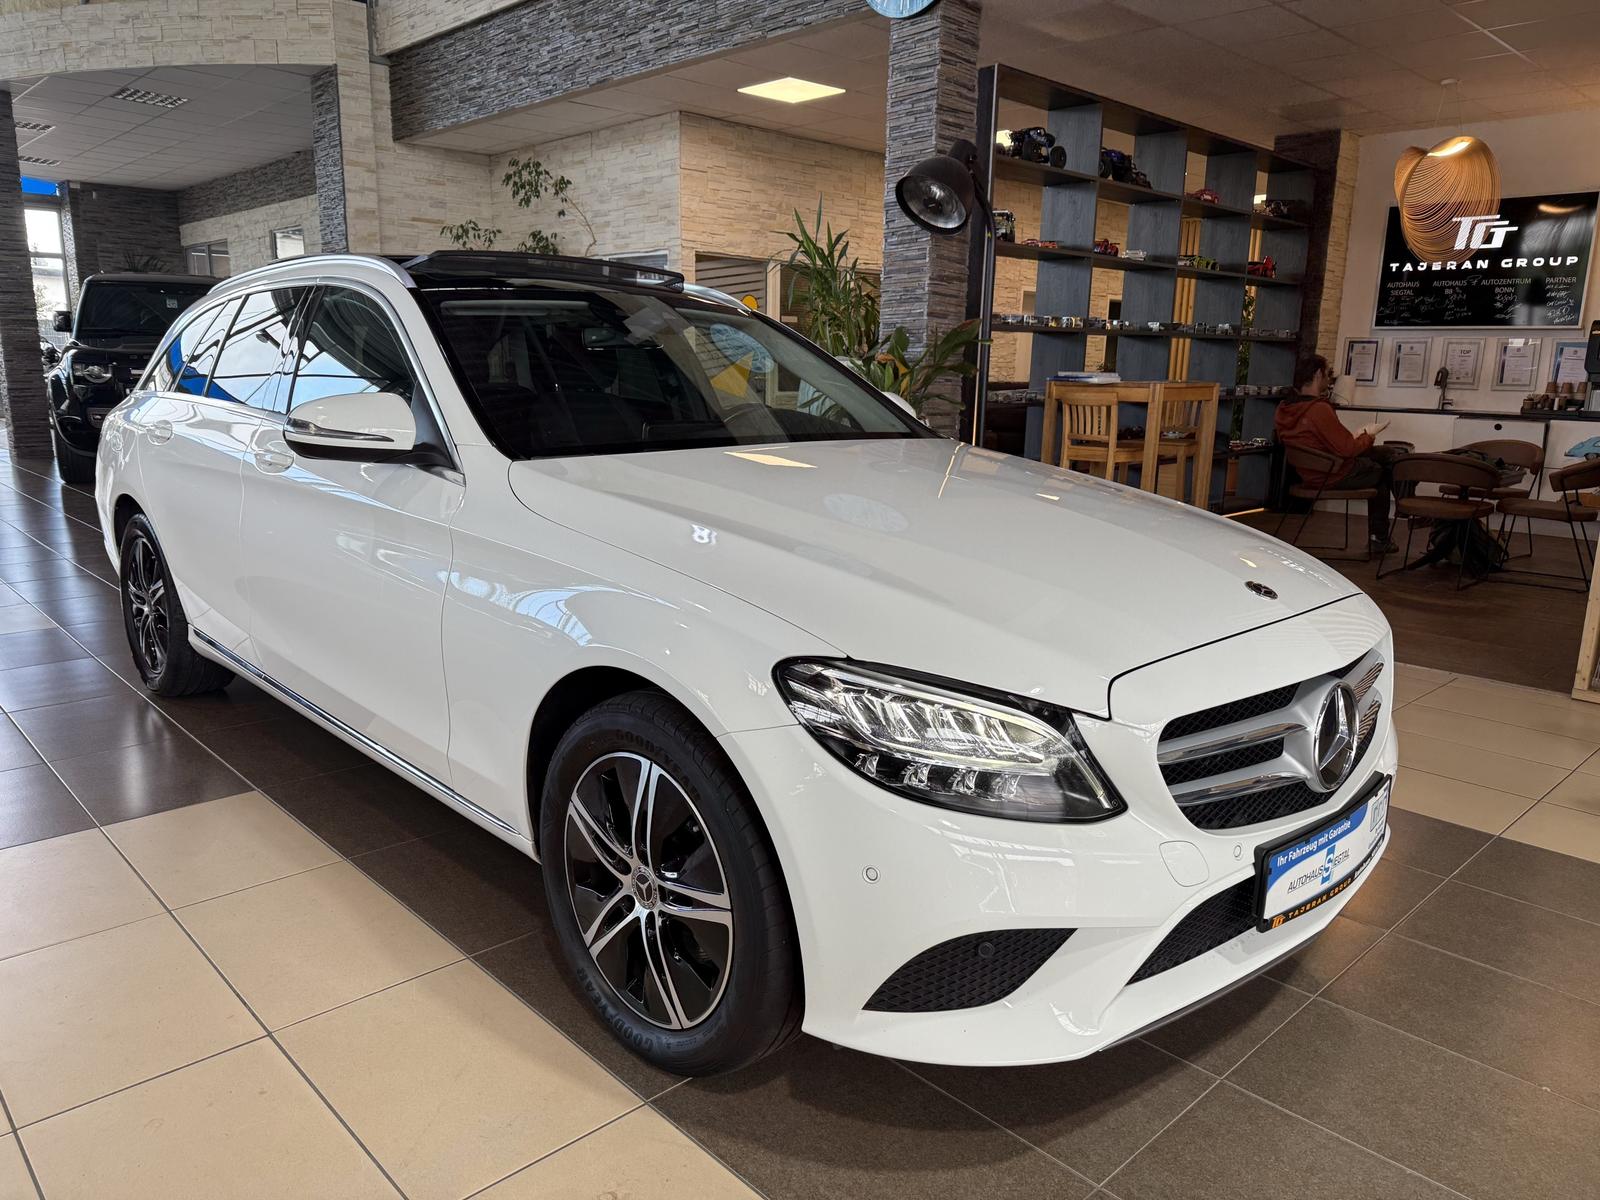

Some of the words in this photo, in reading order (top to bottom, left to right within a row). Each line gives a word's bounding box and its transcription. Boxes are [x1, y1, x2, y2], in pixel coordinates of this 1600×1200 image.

[1389, 259, 1489, 273] TAJERAN
[1500, 256, 1579, 269] GROUP
[1480, 278, 1532, 286] AUTOZENTRUM
[1545, 276, 1577, 284] PARTNER
[1387, 281, 1420, 289] AUTOHAUS
[1494, 286, 1516, 294] BONN
[1276, 854, 1288, 867] Ihr
[1289, 841, 1318, 861] Fahrzeug
[1317, 833, 1328, 846] mit
[1328, 821, 1351, 839] Garantie
[1288, 864, 1324, 891] AUTOHAUS
